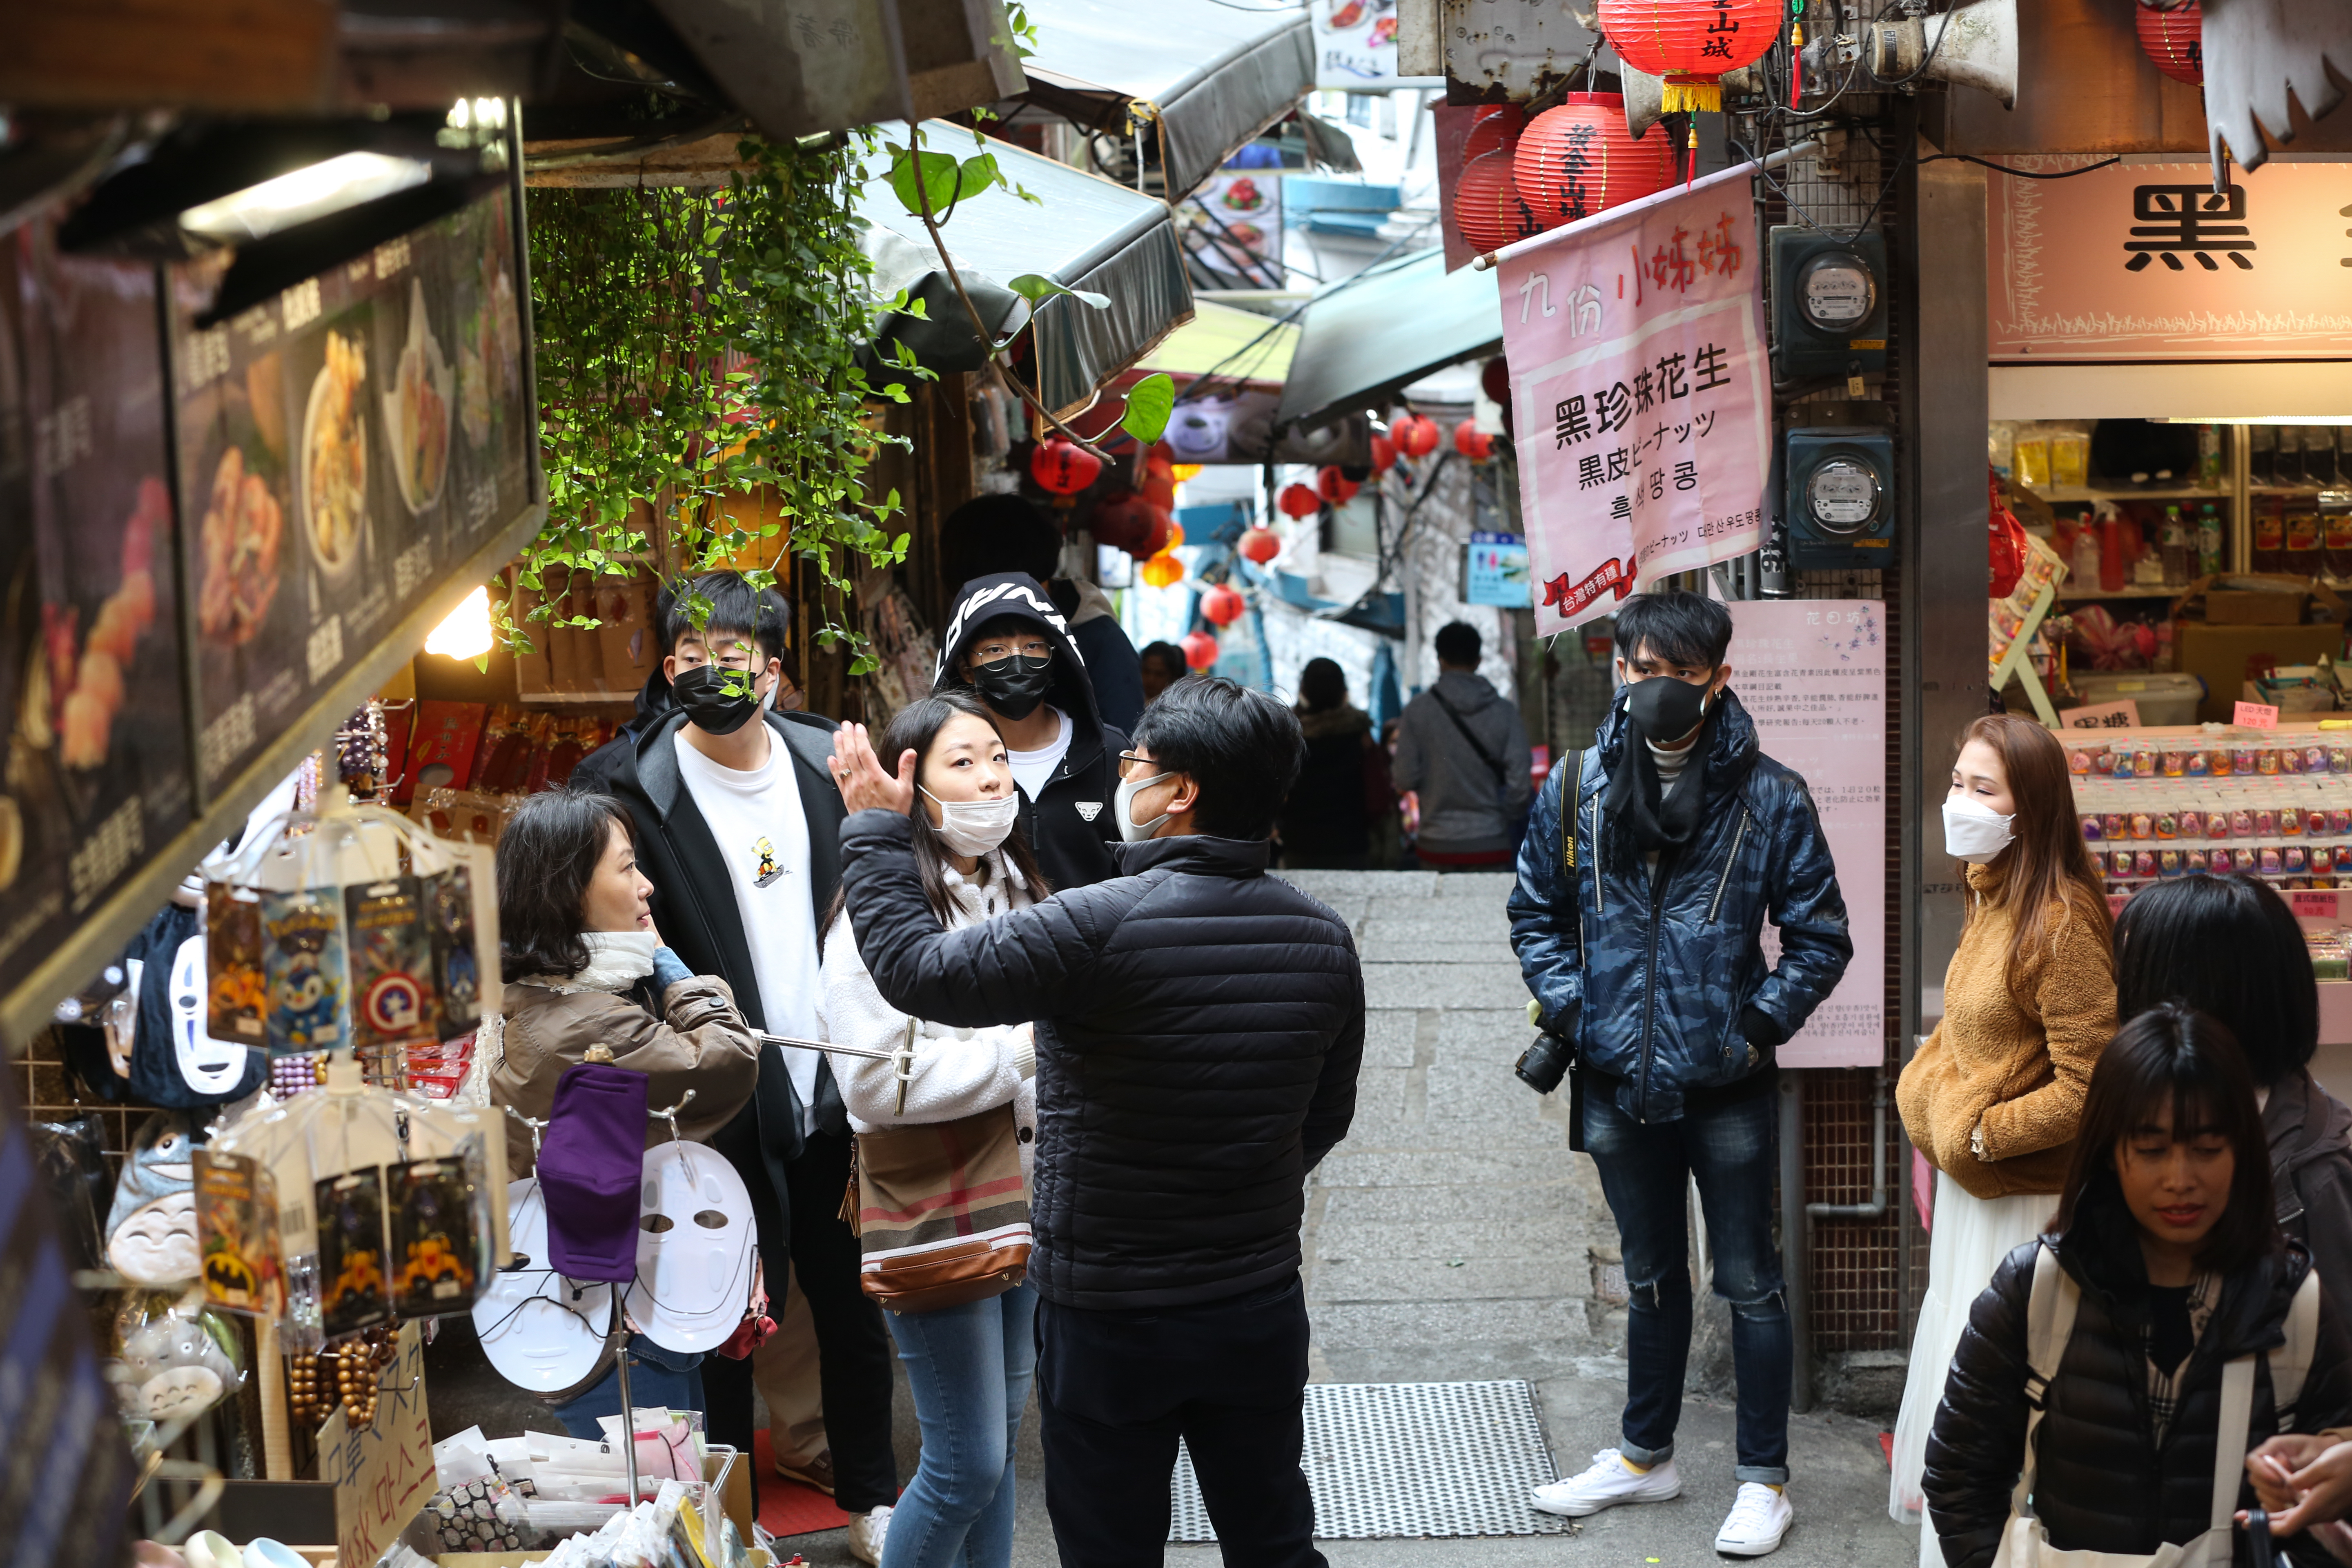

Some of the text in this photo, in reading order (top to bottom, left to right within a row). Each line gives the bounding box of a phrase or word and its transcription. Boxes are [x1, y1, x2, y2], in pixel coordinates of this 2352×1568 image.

[2123, 185, 2257, 271] 黑
[1556, 343, 1731, 450] 黑珍珠花生
[1563, 564, 1618, 611] 台灣特有種
[1567, 835, 1575, 867] Nikon
[376, 1418, 436, 1526] 마스크
